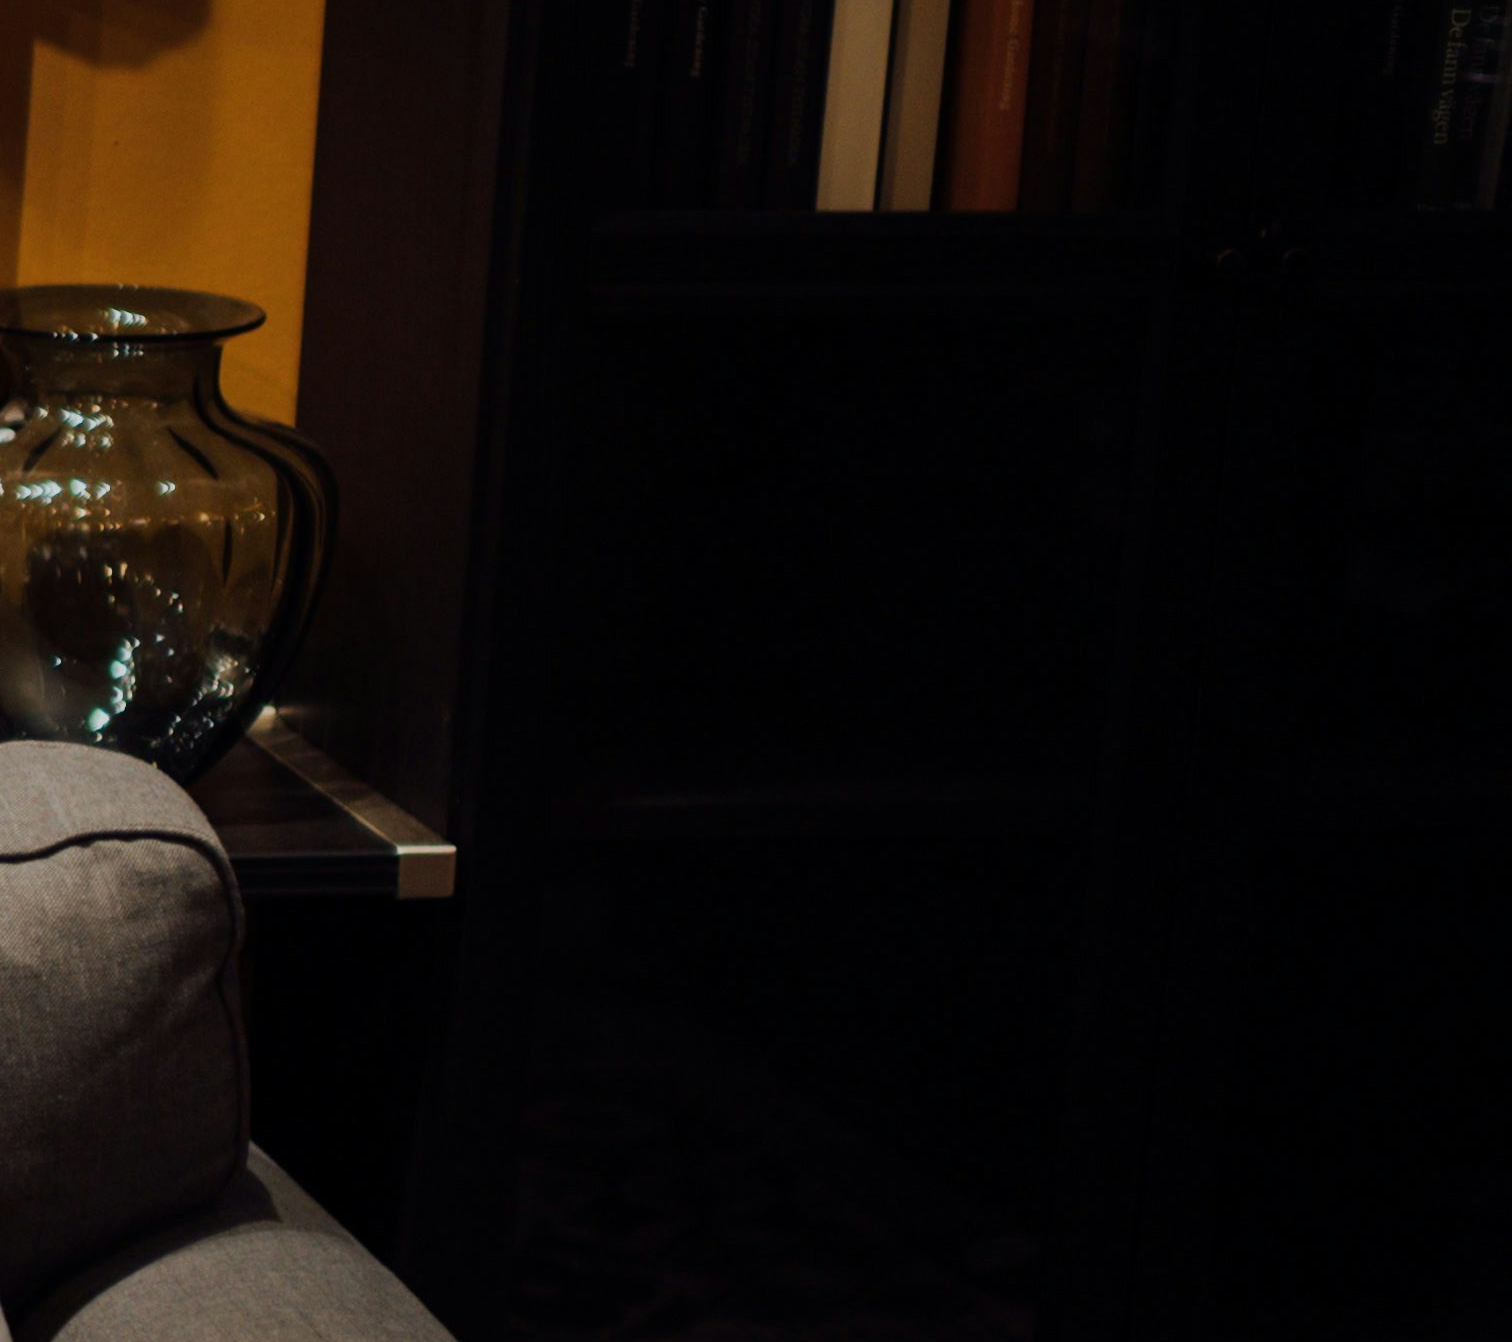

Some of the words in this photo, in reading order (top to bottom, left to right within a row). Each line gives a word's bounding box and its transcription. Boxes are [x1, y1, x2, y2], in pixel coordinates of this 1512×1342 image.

[1449, 9, 1472, 39] De
[1442, 41, 1467, 84] fann
[1432, 89, 1456, 147] vägen
